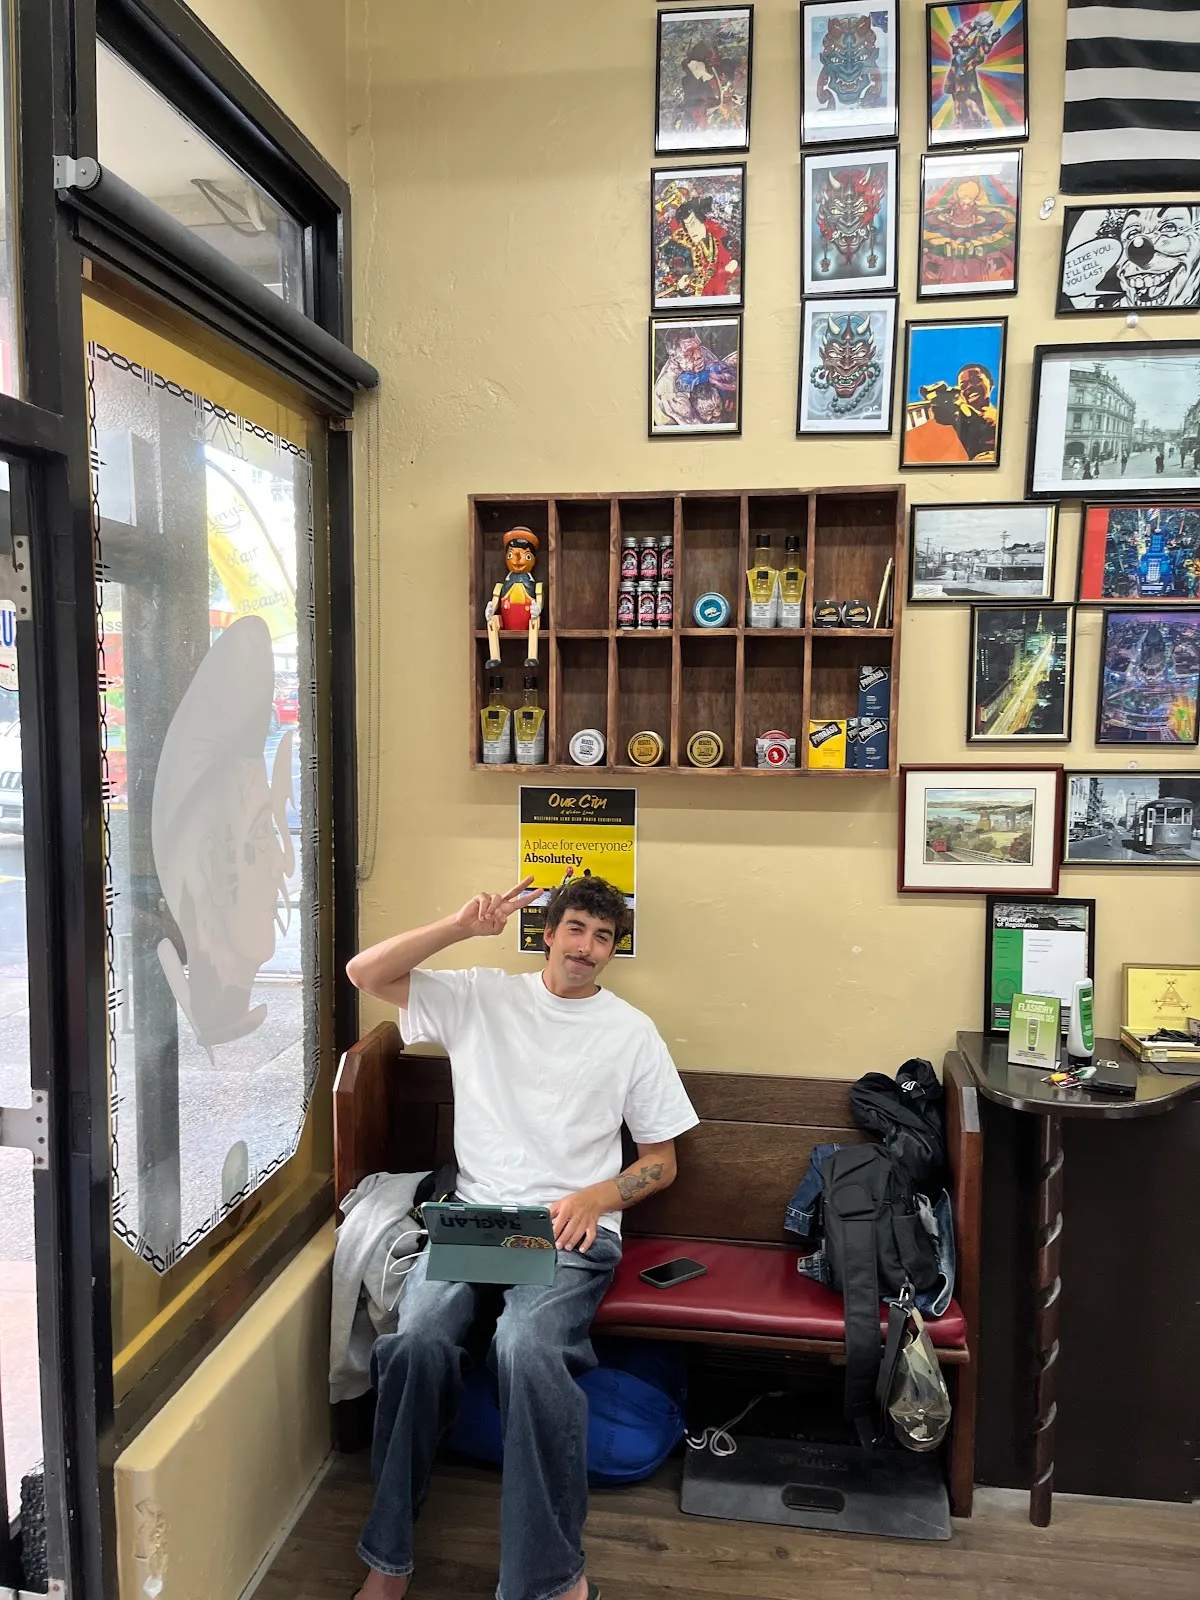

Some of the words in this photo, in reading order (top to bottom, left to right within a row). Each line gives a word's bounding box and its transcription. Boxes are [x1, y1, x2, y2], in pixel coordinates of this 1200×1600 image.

[1073, 252, 1091, 265] LIKE
[1083, 261, 1099, 271] KILL
[1066, 276, 1082, 286] YOU
[1084, 266, 1102, 280] LAST
[524, 839, 531, 850] A
[533, 838, 558, 852] place
[560, 839, 574, 850] for
[575, 840, 633, 853] everyone?
[524, 852, 583, 867] Absolutely
